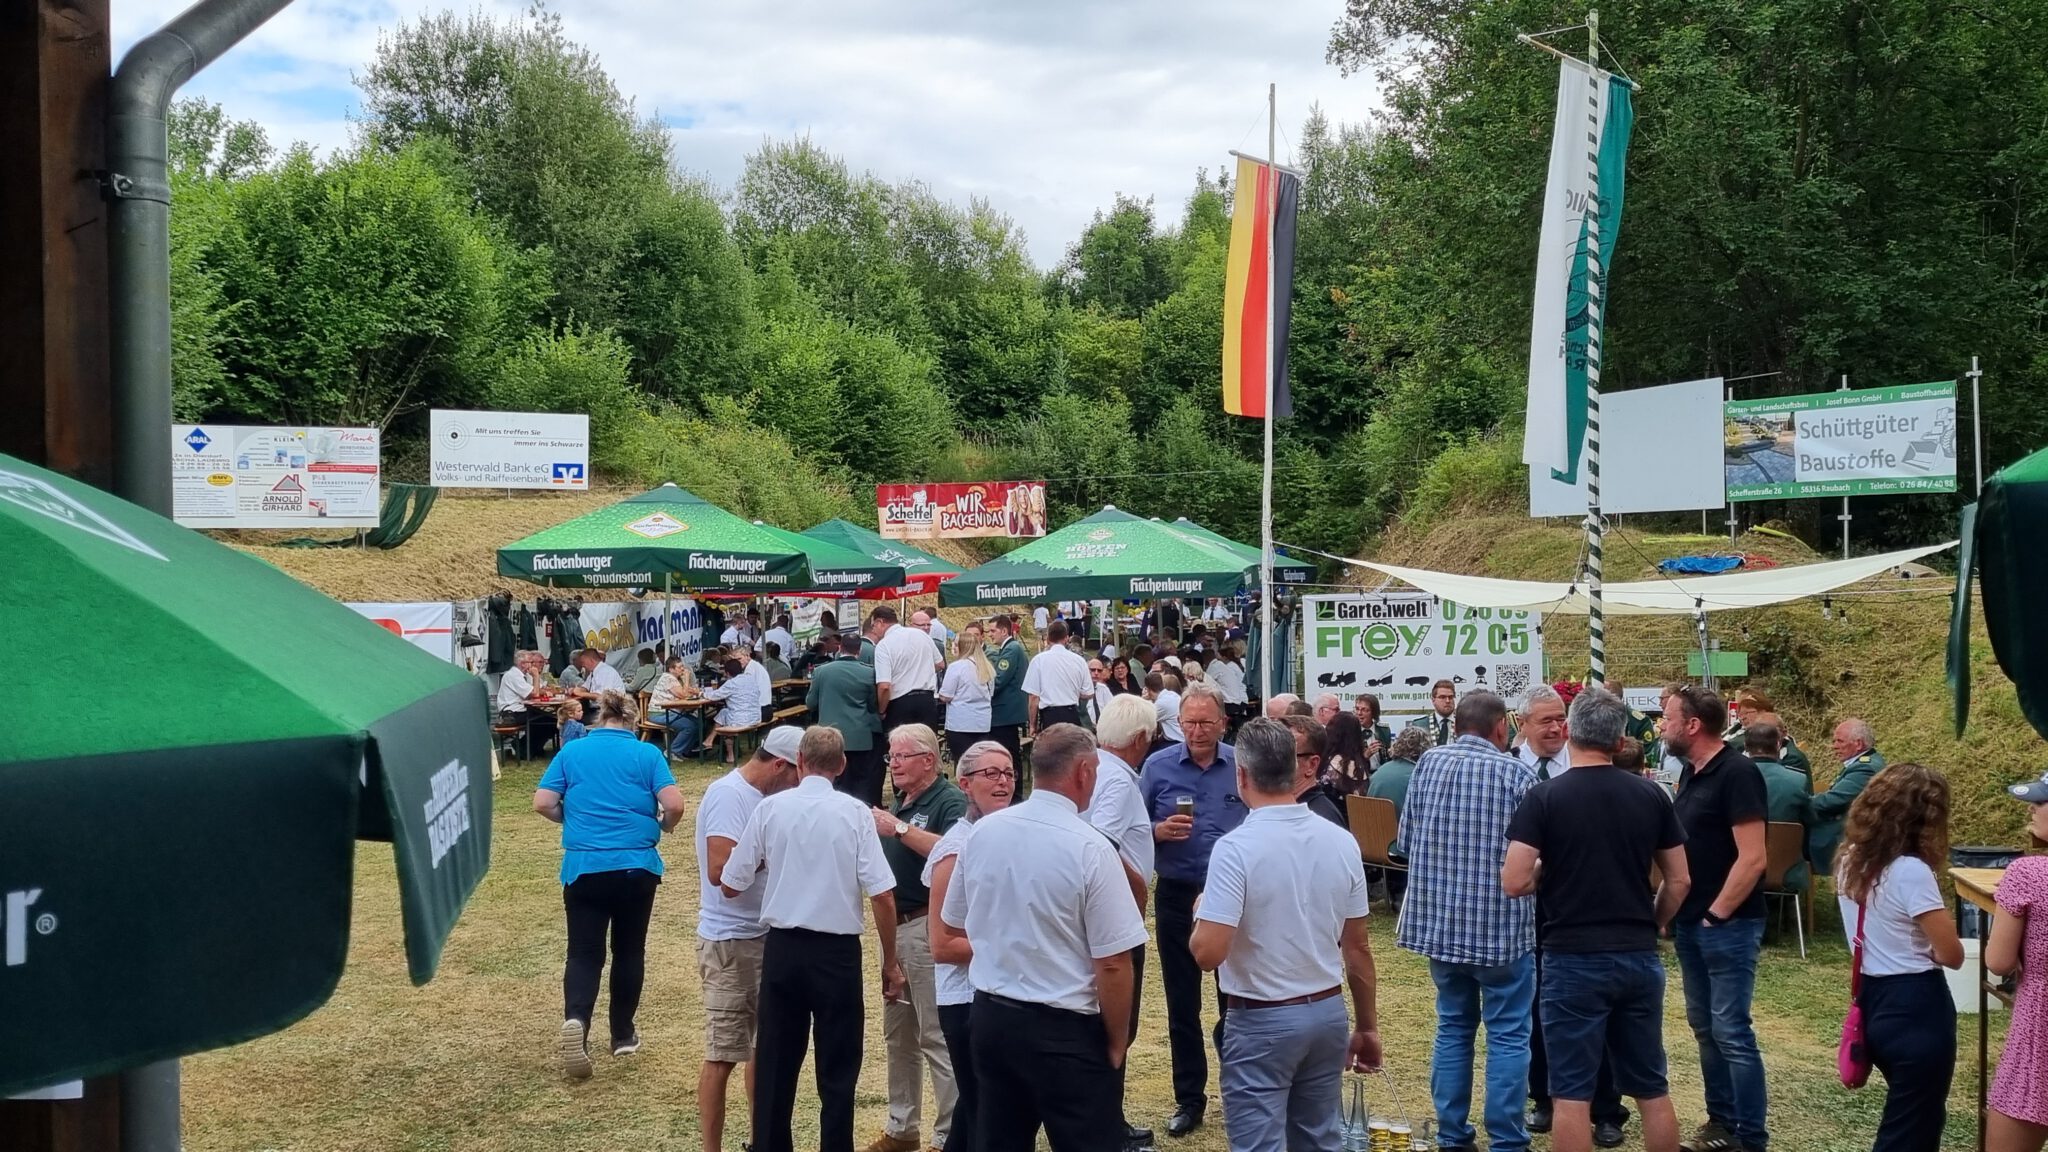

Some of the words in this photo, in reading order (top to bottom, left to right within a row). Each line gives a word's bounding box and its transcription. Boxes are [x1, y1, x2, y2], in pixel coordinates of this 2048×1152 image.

[1901, 387, 1952, 399] Baustoffhandel
[1826, 397, 1842, 405] Josef
[1727, 406, 1749, 414] Garten-
[1762, 402, 1808, 411] Landschaftsbau
[1800, 415, 1919, 440] Schüttgüter
[1800, 449, 1896, 472] Baustoffe
[435, 461, 500, 472] Westerwald
[504, 463, 531, 473] Bank
[534, 464, 549, 473] eG
[435, 473, 461, 482] Volks-
[465, 474, 482, 482] und
[485, 474, 549, 483] Raiffeisenbank
[1821, 484, 1850, 492] Raubach
[263, 495, 300, 503] ARNOLD
[955, 492, 986, 512] WIR
[941, 512, 983, 529] BACKEN
[985, 511, 1004, 527] DAS
[1442, 624, 1478, 656] 72
[1487, 623, 1529, 655] 05
